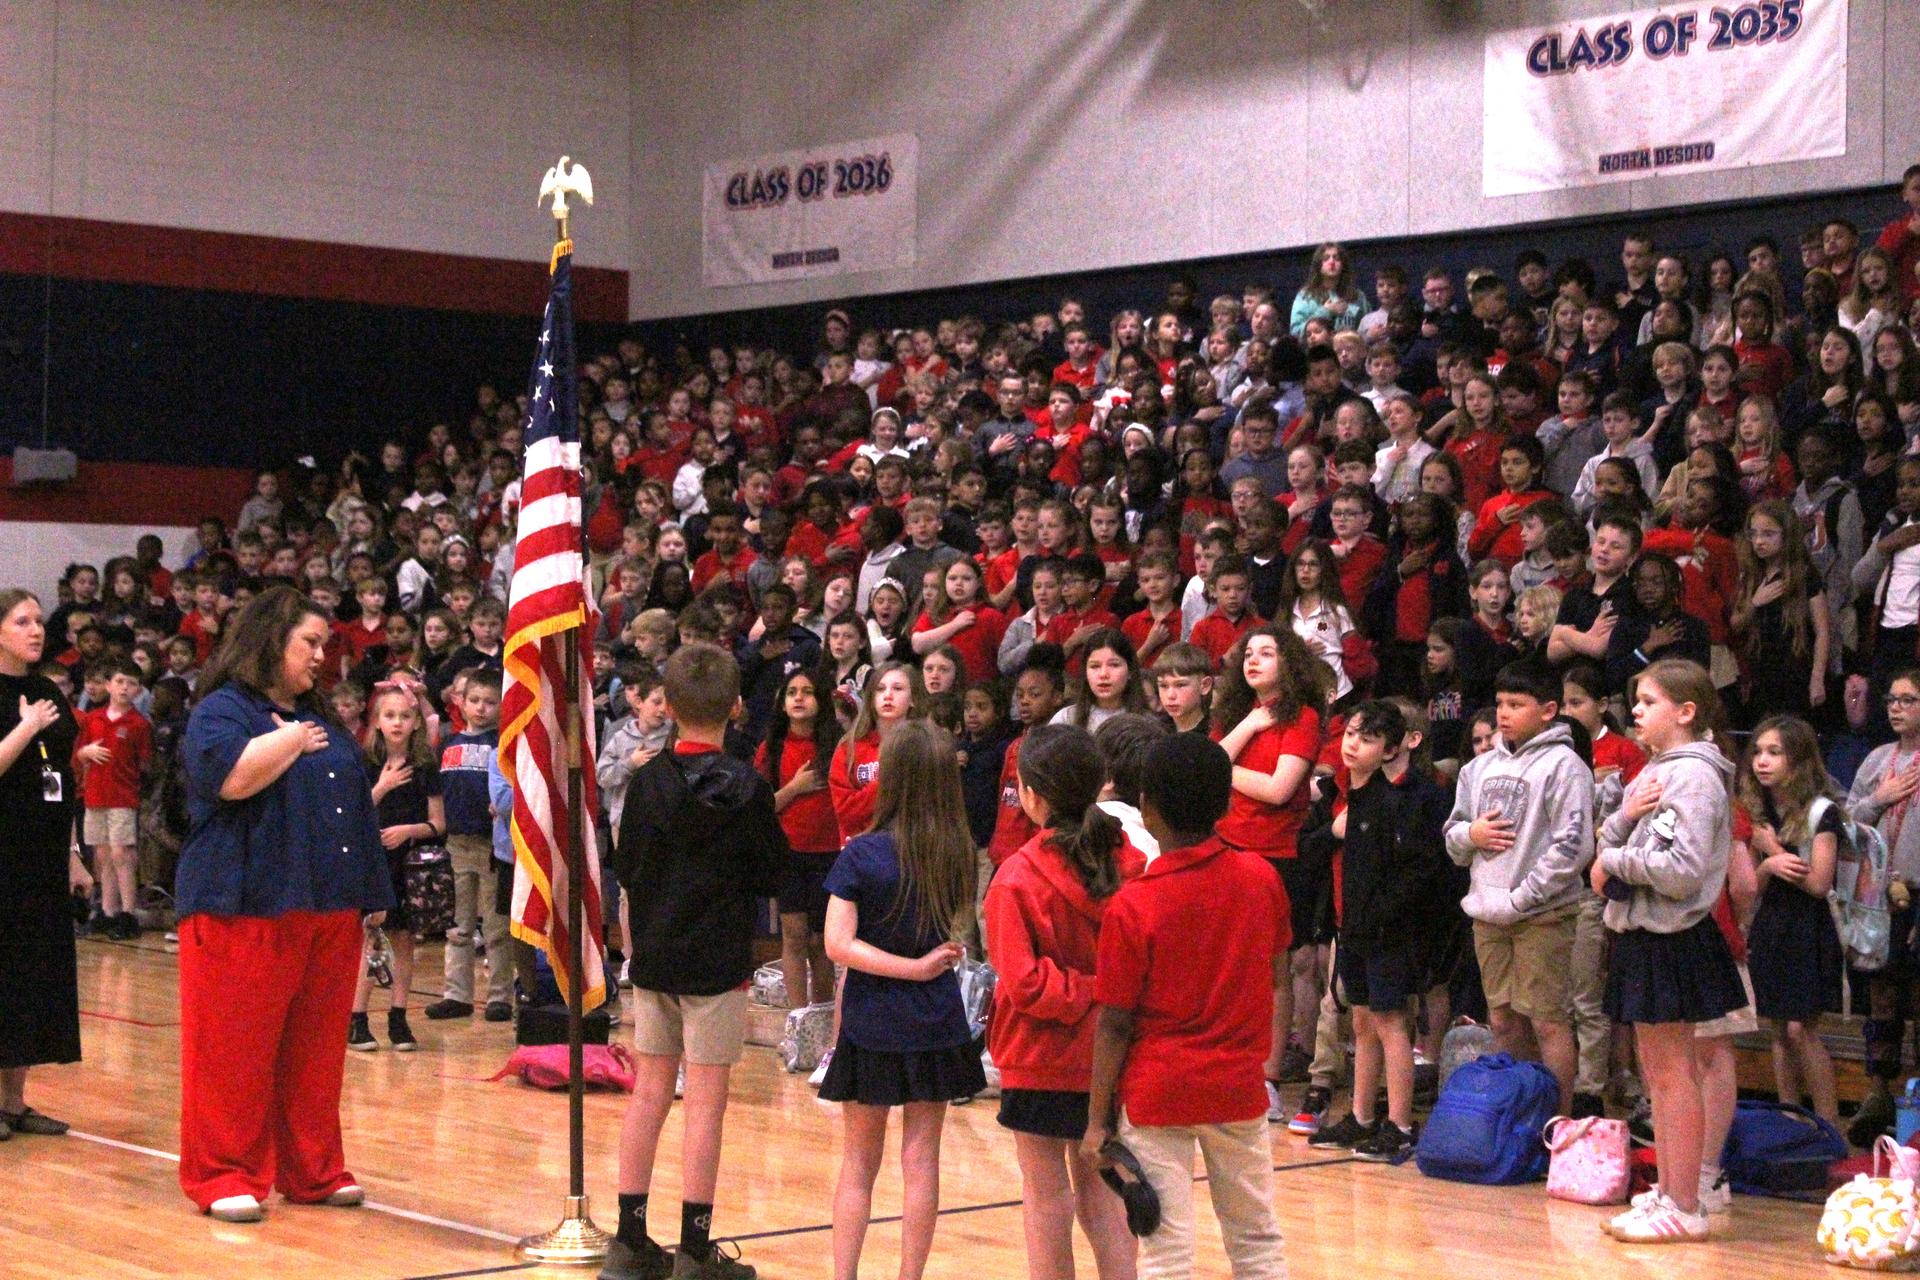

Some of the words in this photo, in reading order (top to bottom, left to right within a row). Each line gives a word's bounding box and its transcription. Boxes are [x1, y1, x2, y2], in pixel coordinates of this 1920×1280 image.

[1526, 20, 1632, 78] CLASS
[1643, 11, 1698, 61] OF
[1707, 0, 1803, 50] 2035
[725, 166, 790, 211] CLASS
[797, 161, 829, 203] OF
[833, 152, 893, 199] 2036
[1599, 148, 1651, 174] NORTH
[1653, 141, 1715, 169] DESOTO
